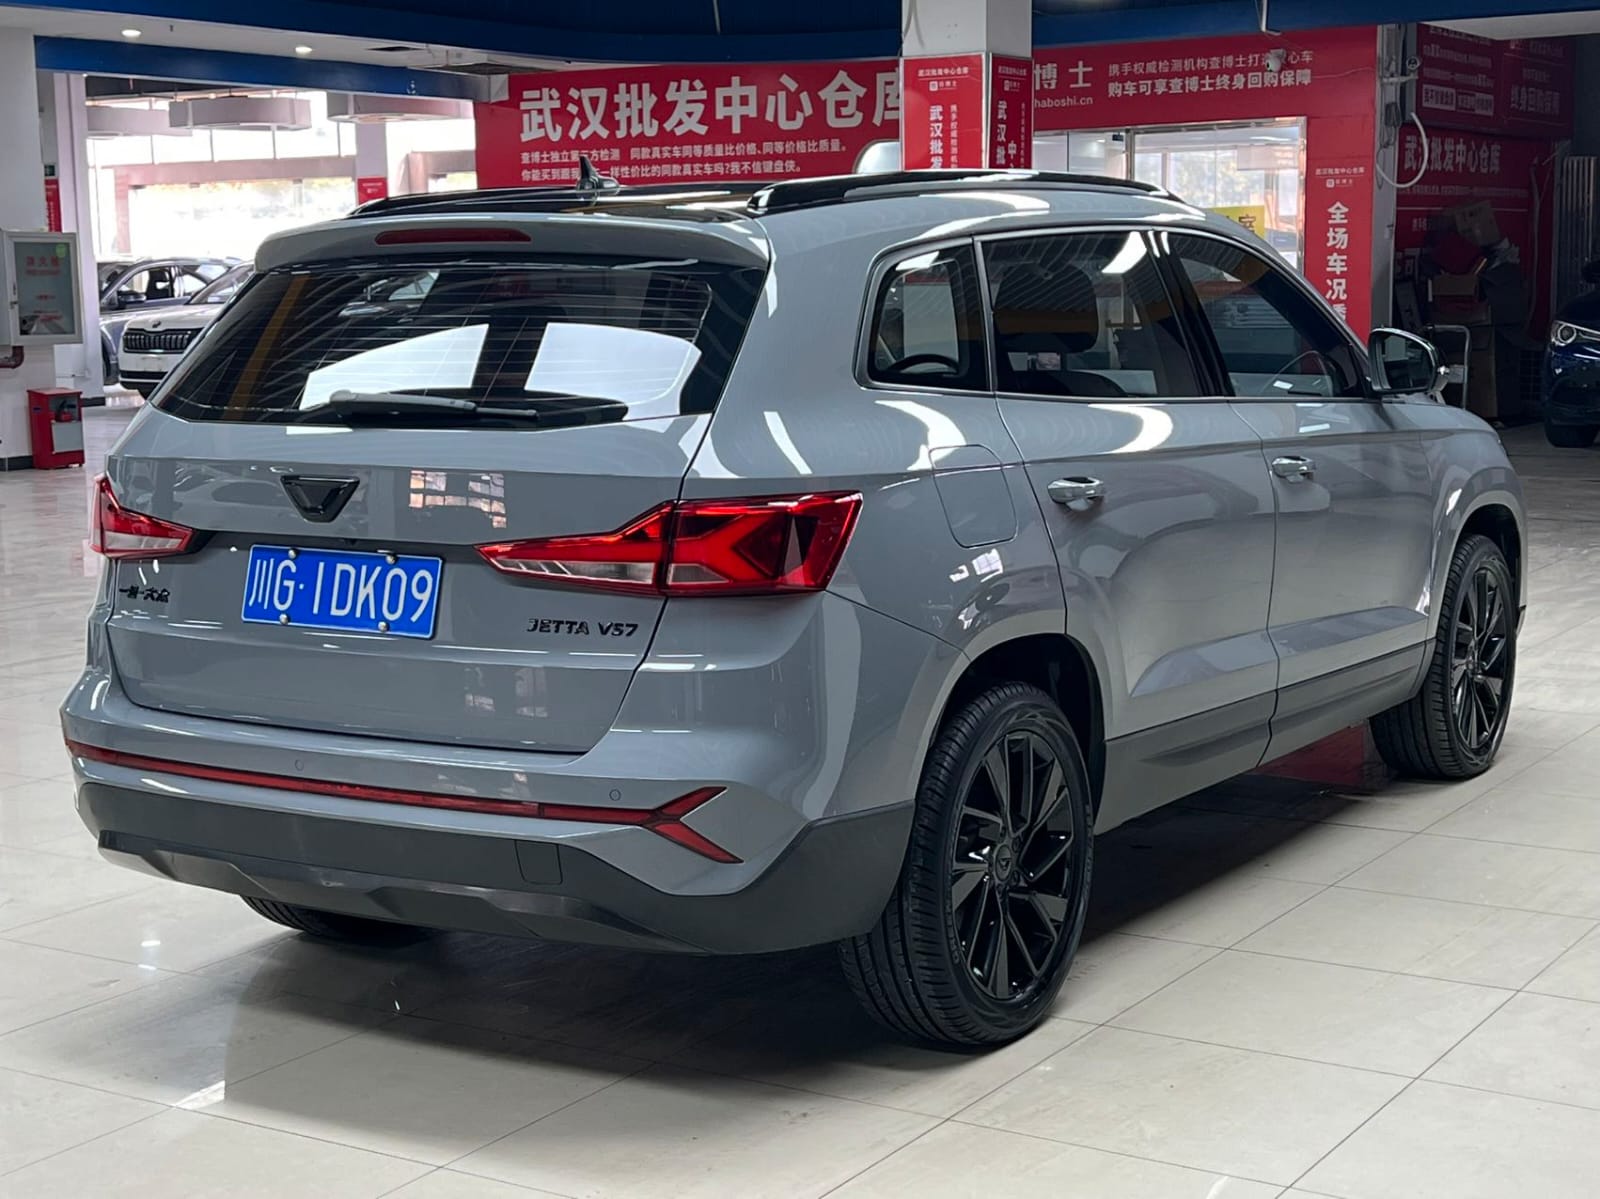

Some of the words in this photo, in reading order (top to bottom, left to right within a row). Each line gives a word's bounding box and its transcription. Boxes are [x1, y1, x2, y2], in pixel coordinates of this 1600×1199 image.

[1108, 50, 1313, 77] 携手权威检测机构查博士打心车
[1108, 69, 1311, 98] 购车可享查博士终身回购保障
[519, 69, 899, 142] 武汉批发中心仓库
[521, 160, 801, 182] 你能买到跟我一样性价比的同款真实车吗?我不信键盘侠。
[249, 558, 433, 623] 川G·1DK09
[526, 618, 590, 635] JETTA
[598, 621, 639, 638] VS7
